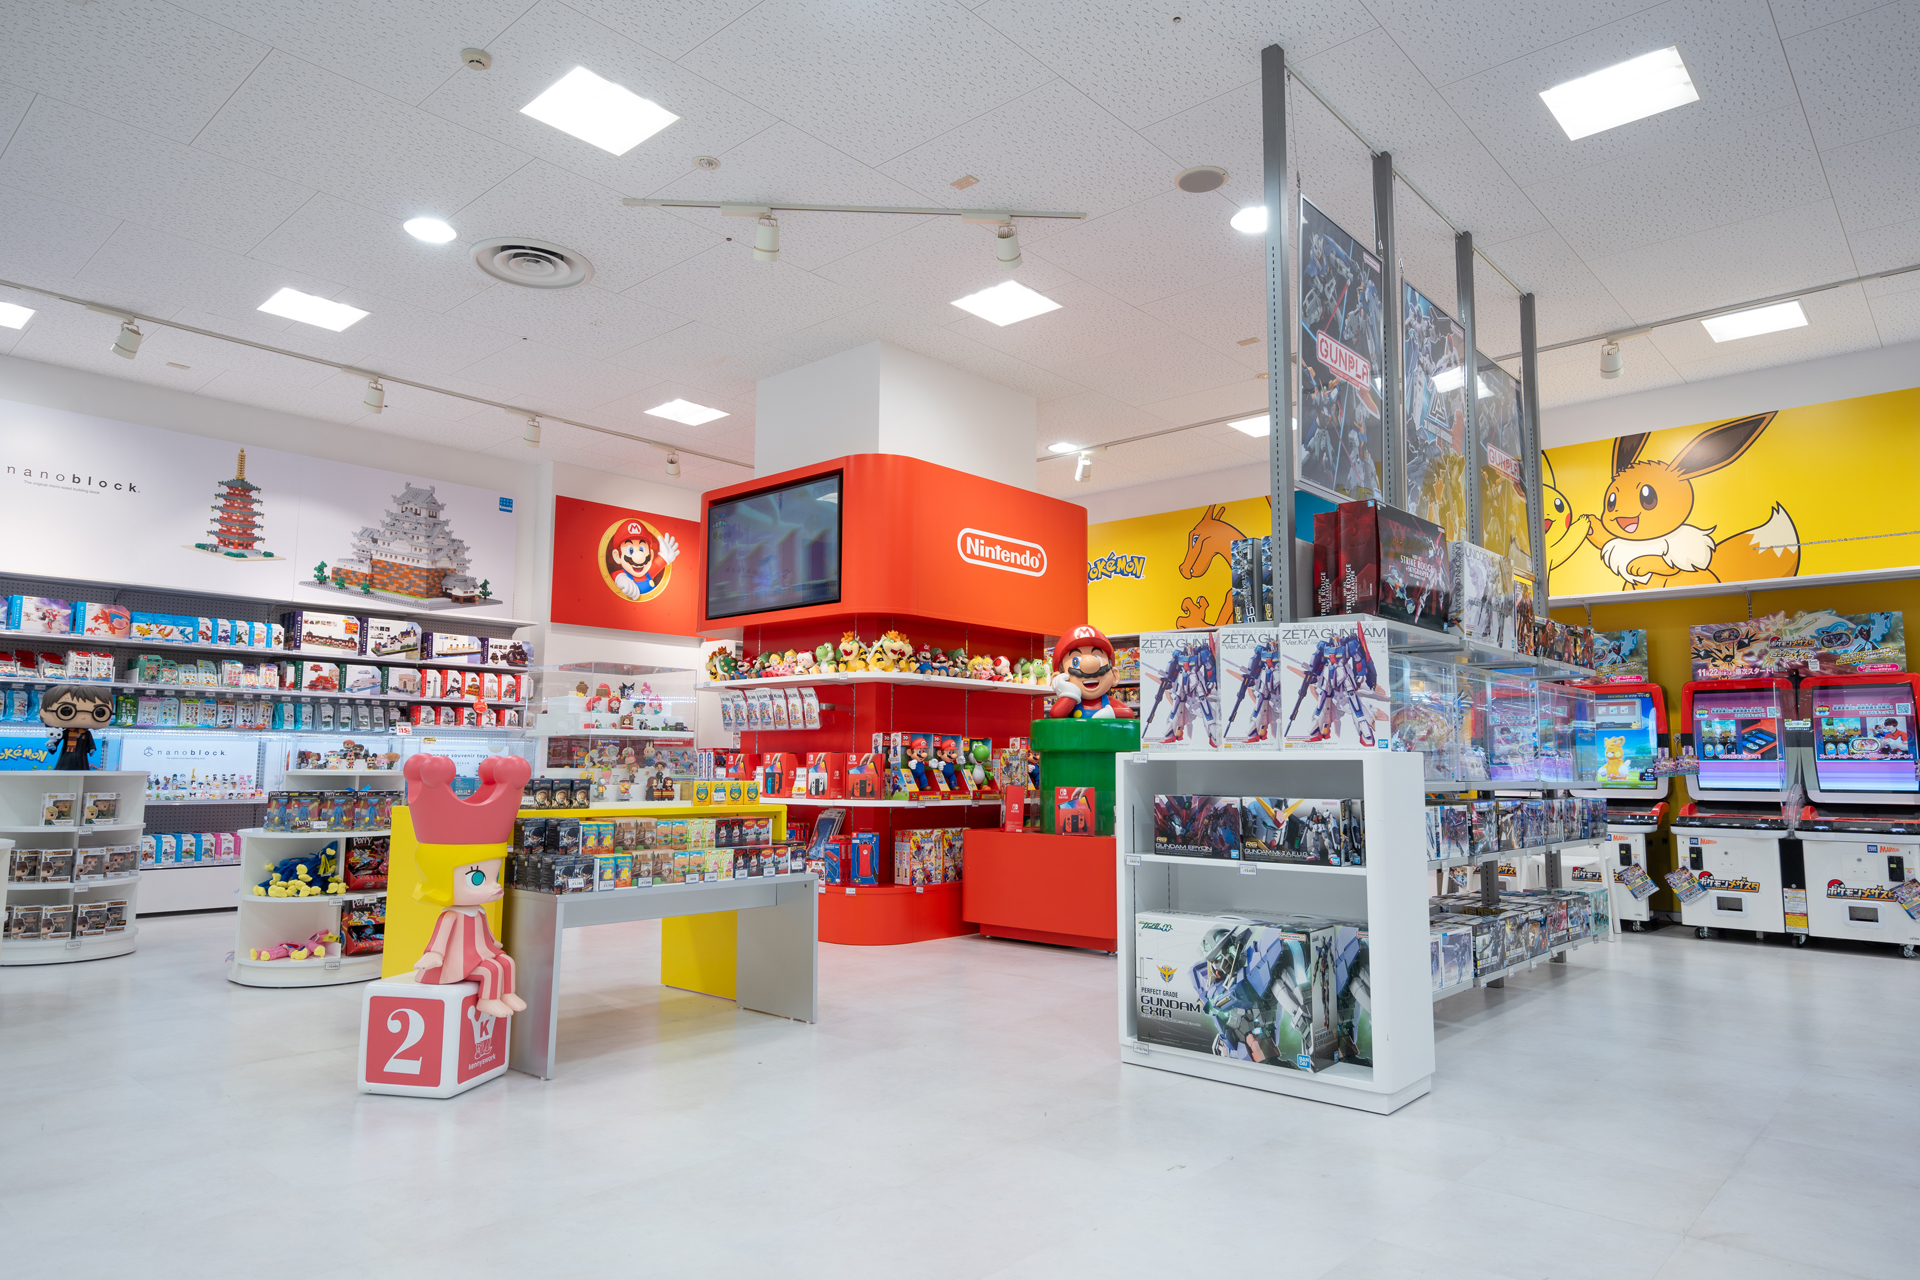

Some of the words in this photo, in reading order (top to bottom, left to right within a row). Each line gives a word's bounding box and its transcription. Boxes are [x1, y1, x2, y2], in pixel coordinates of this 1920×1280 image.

[1319, 338, 1369, 384] GUNPLA
[1488, 449, 1520, 478] GUNPLA
[7, 465, 137, 493] nanoblock
[966, 536, 1040, 569] Nintendo
[1221, 634, 1257, 644] ZETA
[1282, 629, 1319, 640] ZETA
[1141, 639, 1175, 649] ZETA
[0, 744, 48, 763] okémon
[1155, 843, 1187, 851] GUNDAM
[1700, 876, 1760, 892] ポケモンメザスタ
[1141, 987, 1162, 996] PERFECT
[1162, 989, 1179, 999] GRADE
[1141, 995, 1201, 1013] GUNDAM
[1141, 1005, 1172, 1019] EXIA
[480, 1019, 490, 1039] K
[383, 1008, 425, 1075] 2
[468, 1053, 496, 1071] kennyswork
